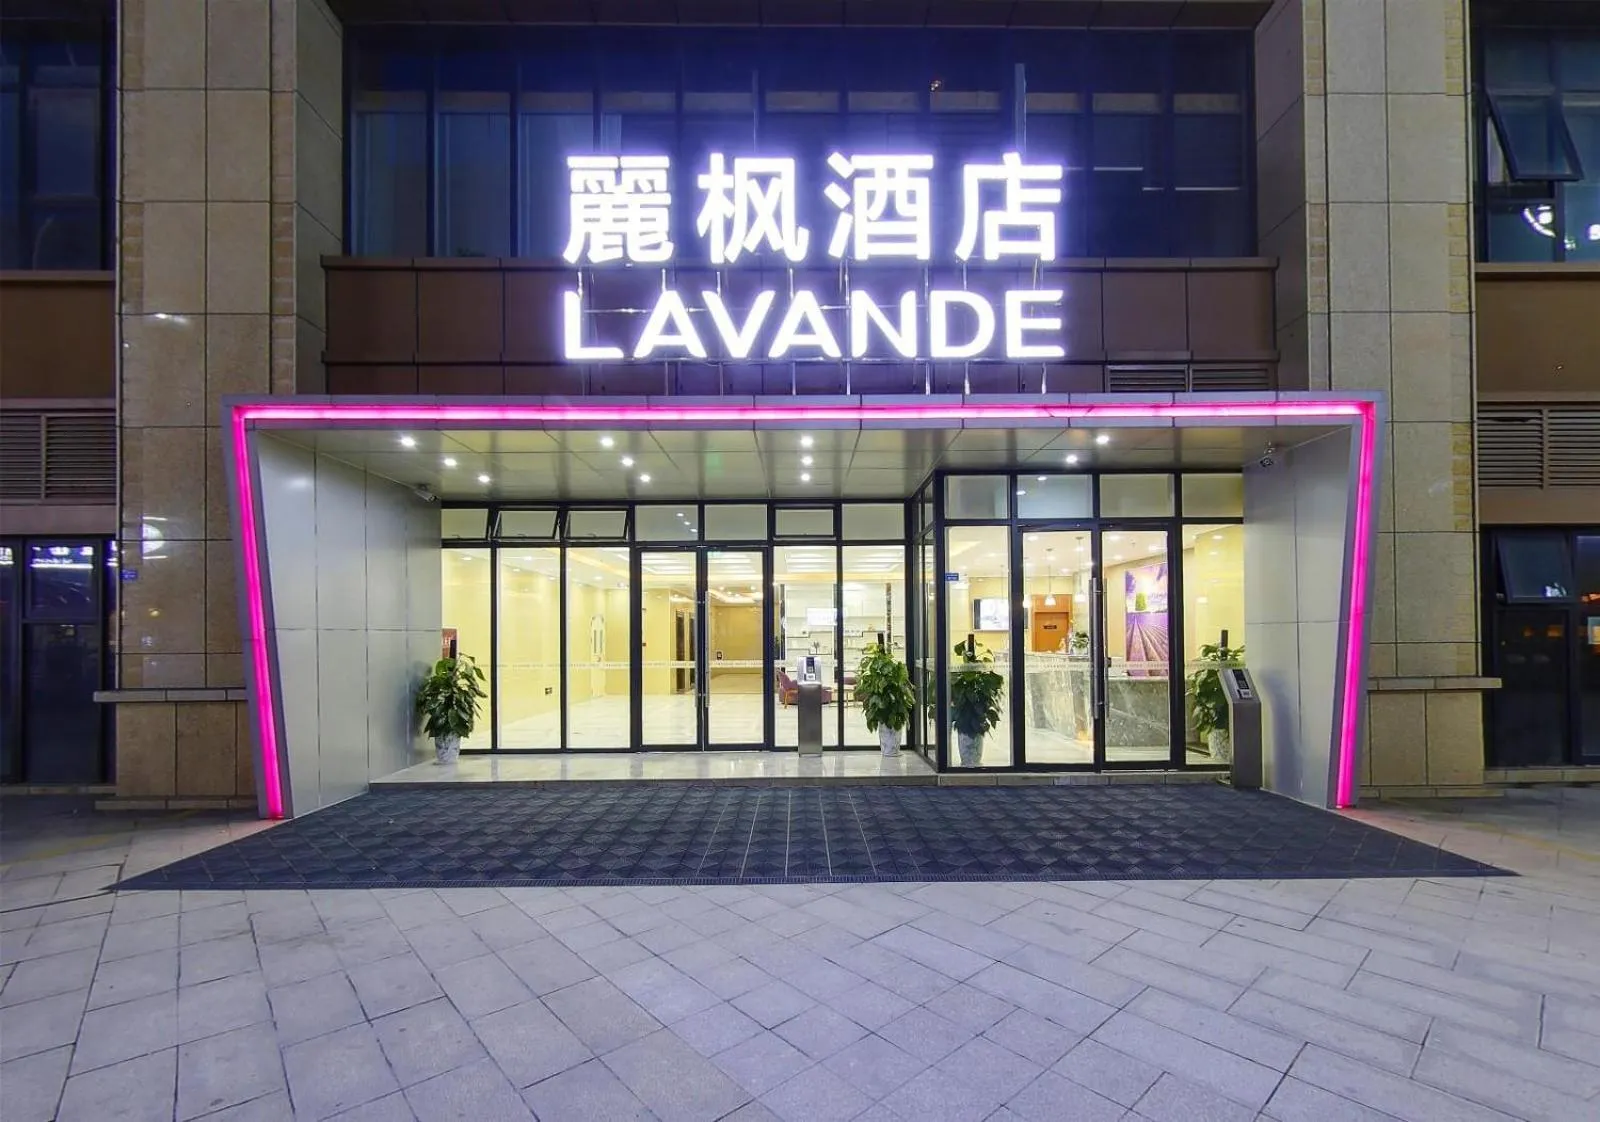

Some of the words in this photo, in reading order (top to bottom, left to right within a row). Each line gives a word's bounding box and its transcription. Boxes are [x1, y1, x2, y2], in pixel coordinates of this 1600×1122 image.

[563, 152, 1063, 264] 麗枫酒店
[564, 289, 1065, 360] LAVANDE
